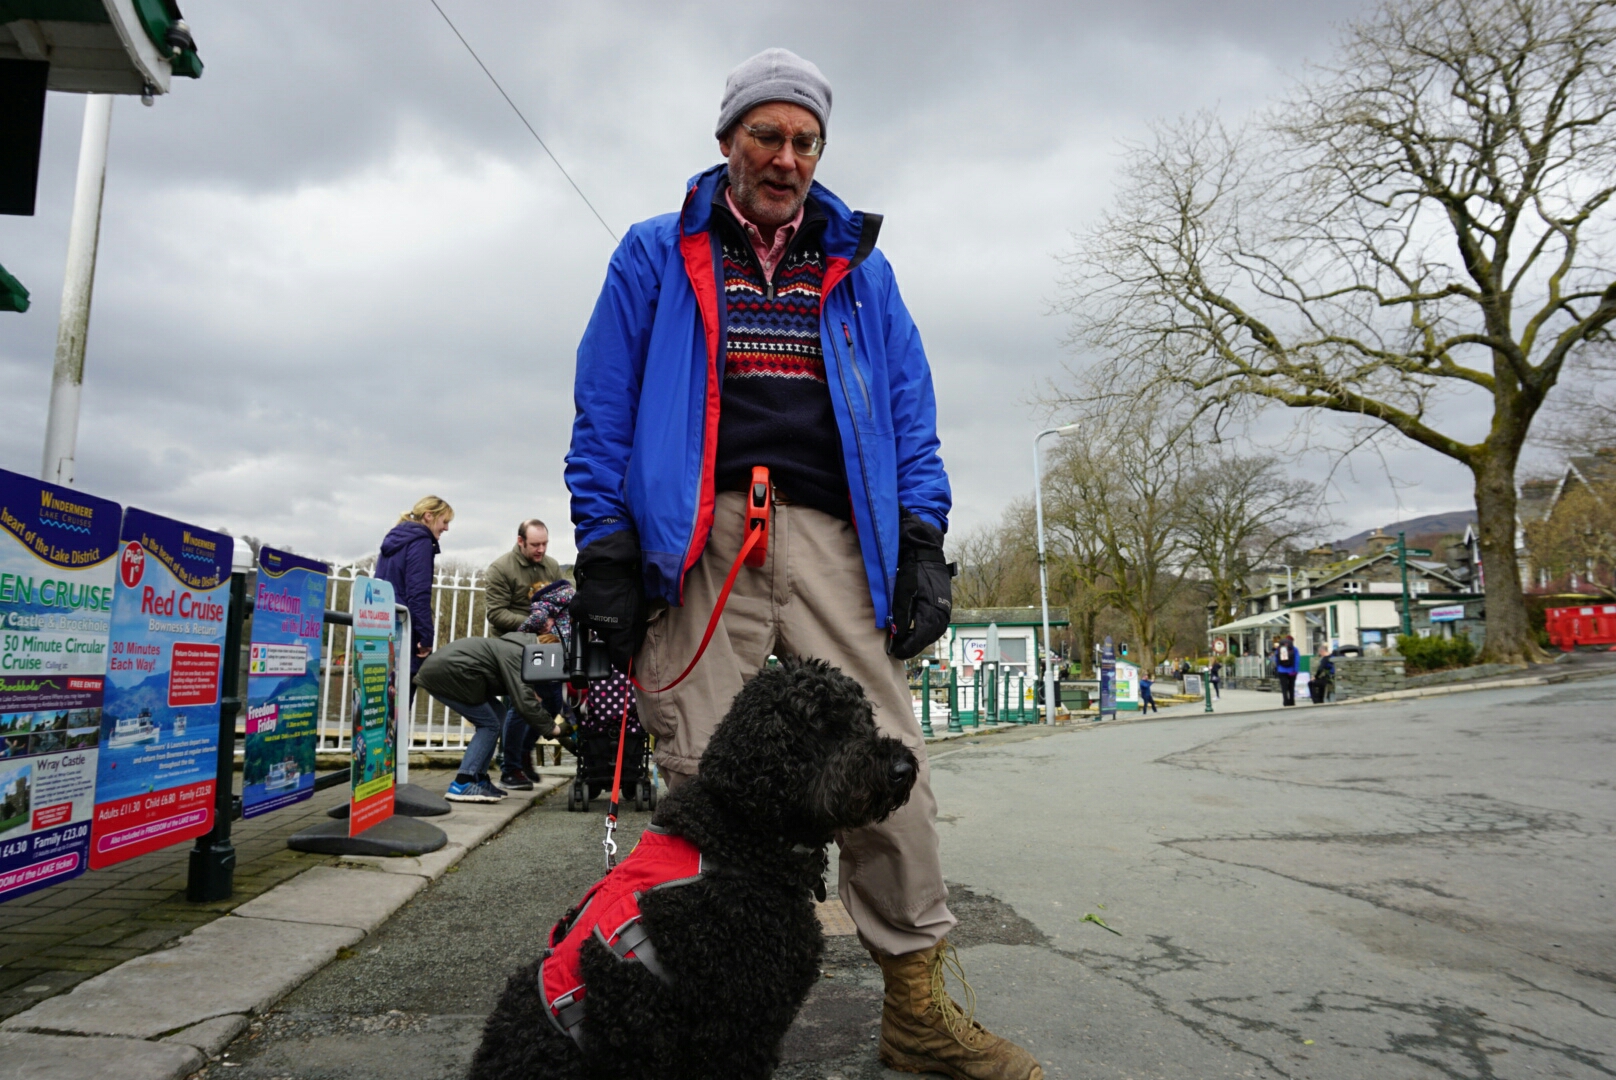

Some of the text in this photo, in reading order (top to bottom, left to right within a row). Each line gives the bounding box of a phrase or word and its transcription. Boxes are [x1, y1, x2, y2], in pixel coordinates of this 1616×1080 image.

[41, 490, 93, 518] WINDERMERE
[40, 508, 92, 528] LAKE CRUISES
[1, 506, 100, 564] heart of the Lake District
[183, 531, 216, 551] WINDERMERE
[125, 549, 144, 564] Pier
[188, 573, 201, 587] Lake
[39, 578, 112, 612] CRUISE
[141, 585, 224, 622] Red Cruise
[257, 583, 301, 614] Freedom
[8, 611, 44, 628] Castle
[48, 615, 56, 629] &
[59, 616, 108, 632] Brockhole
[149, 618, 217, 636] Bowness & Return
[281, 612, 321, 639] of the Lake
[4, 634, 106, 654] 50 Minute Circular
[112, 641, 161, 656] 30 Minutes
[2, 652, 42, 670] Cruise
[110, 657, 156, 673] Each Way!
[973, 649, 985, 661] 2
[70, 680, 83, 688] FREE
[83, 681, 102, 689] ENTRY
[248, 702, 275, 720] Freedom
[257, 717, 277, 734] Friday
[37, 754, 86, 772] Wray Castle
[98, 807, 119, 821] Adults
[120, 800, 141, 816] £11.30
[144, 797, 161, 810] Child
[179, 790, 195, 801] Family
[145, 823, 167, 835] FREEDOM
[2, 840, 28, 858] £4.30
[33, 832, 62, 850] Family
[62, 825, 88, 842] £23.00
[16, 872, 25, 883] of
[25, 869, 36, 880] the
[37, 862, 55, 877] LAKE
[55, 857, 74, 870] ticket
